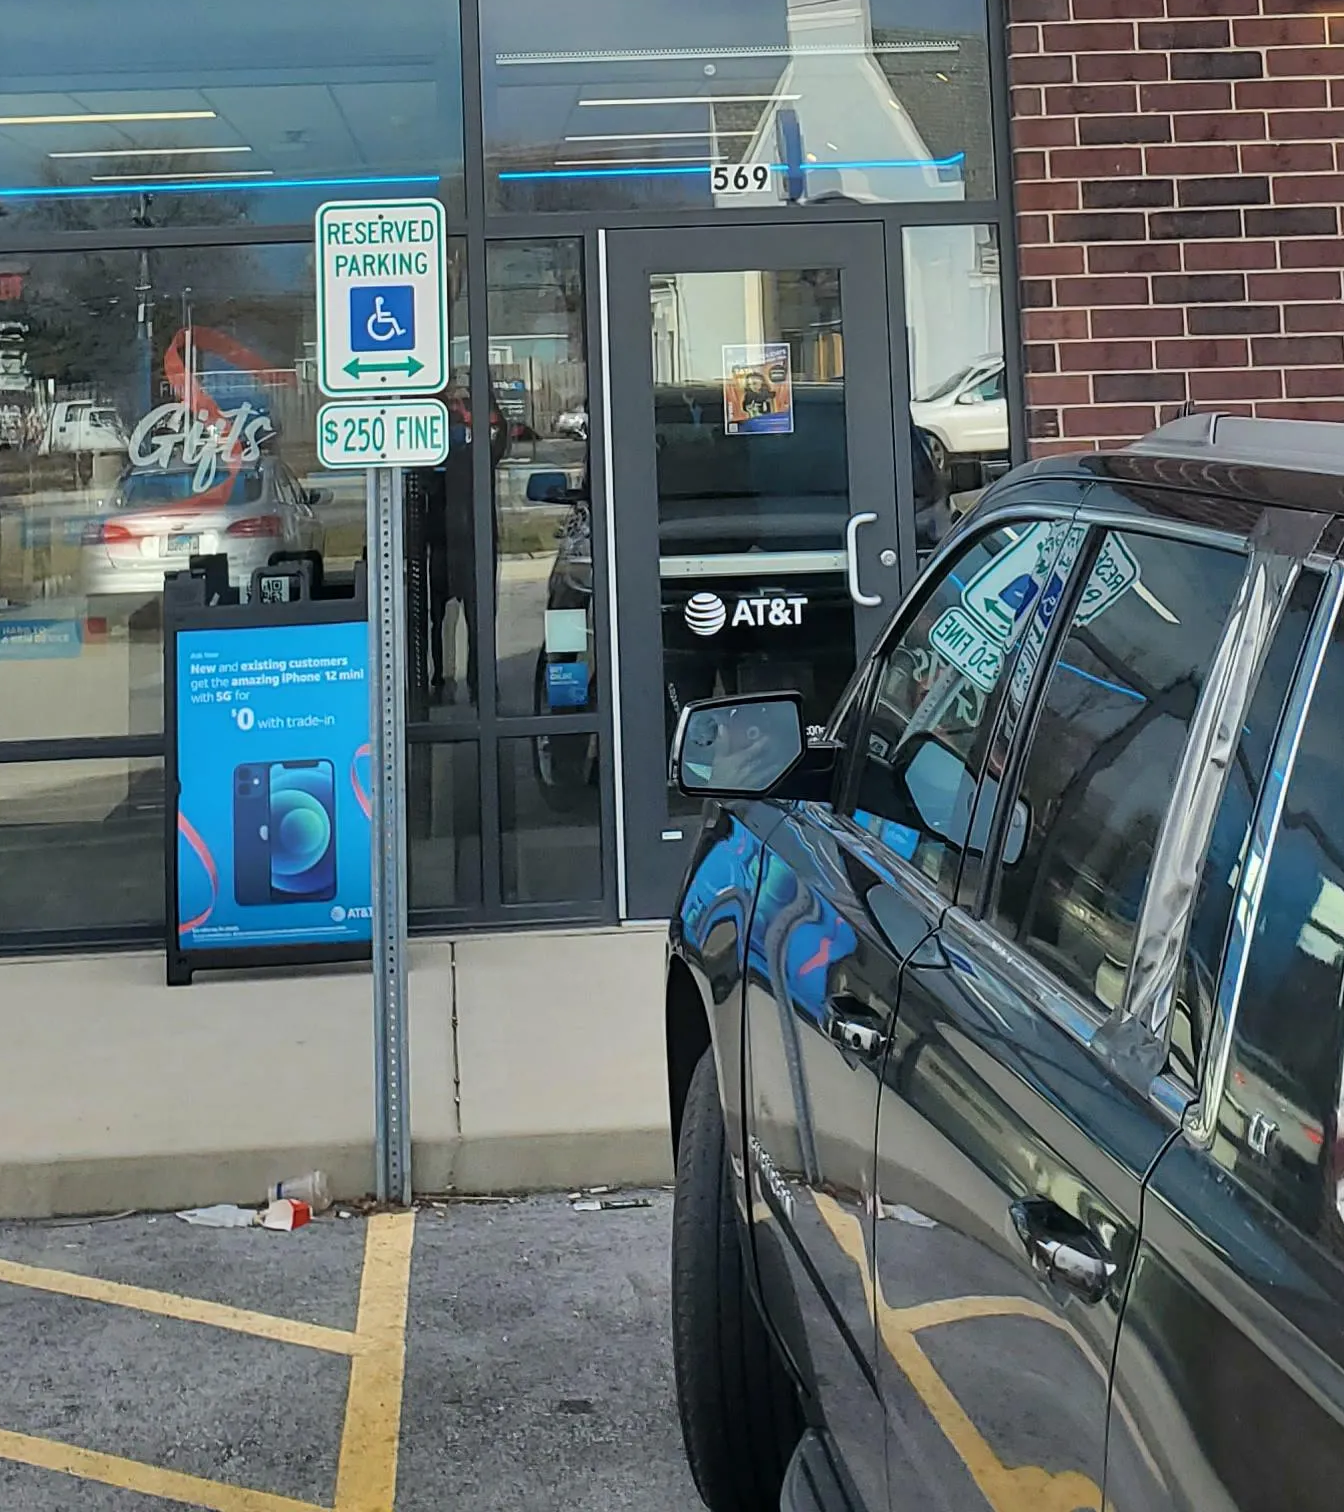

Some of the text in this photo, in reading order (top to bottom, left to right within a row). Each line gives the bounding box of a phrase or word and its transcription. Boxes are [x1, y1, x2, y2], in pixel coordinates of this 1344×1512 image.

[713, 165, 768, 190] 569
[327, 219, 435, 245] RESERVED
[335, 252, 428, 277] PARKING
[395, 415, 443, 450] FINE
[731, 596, 809, 627] AT&T
[190, 656, 348, 675] New and existing customers
[190, 668, 364, 691] get the amazing iPhone 12 mini
[191, 690, 250, 704] with 5G for
[257, 715, 284, 729] with
[286, 714, 335, 728] trade-in
